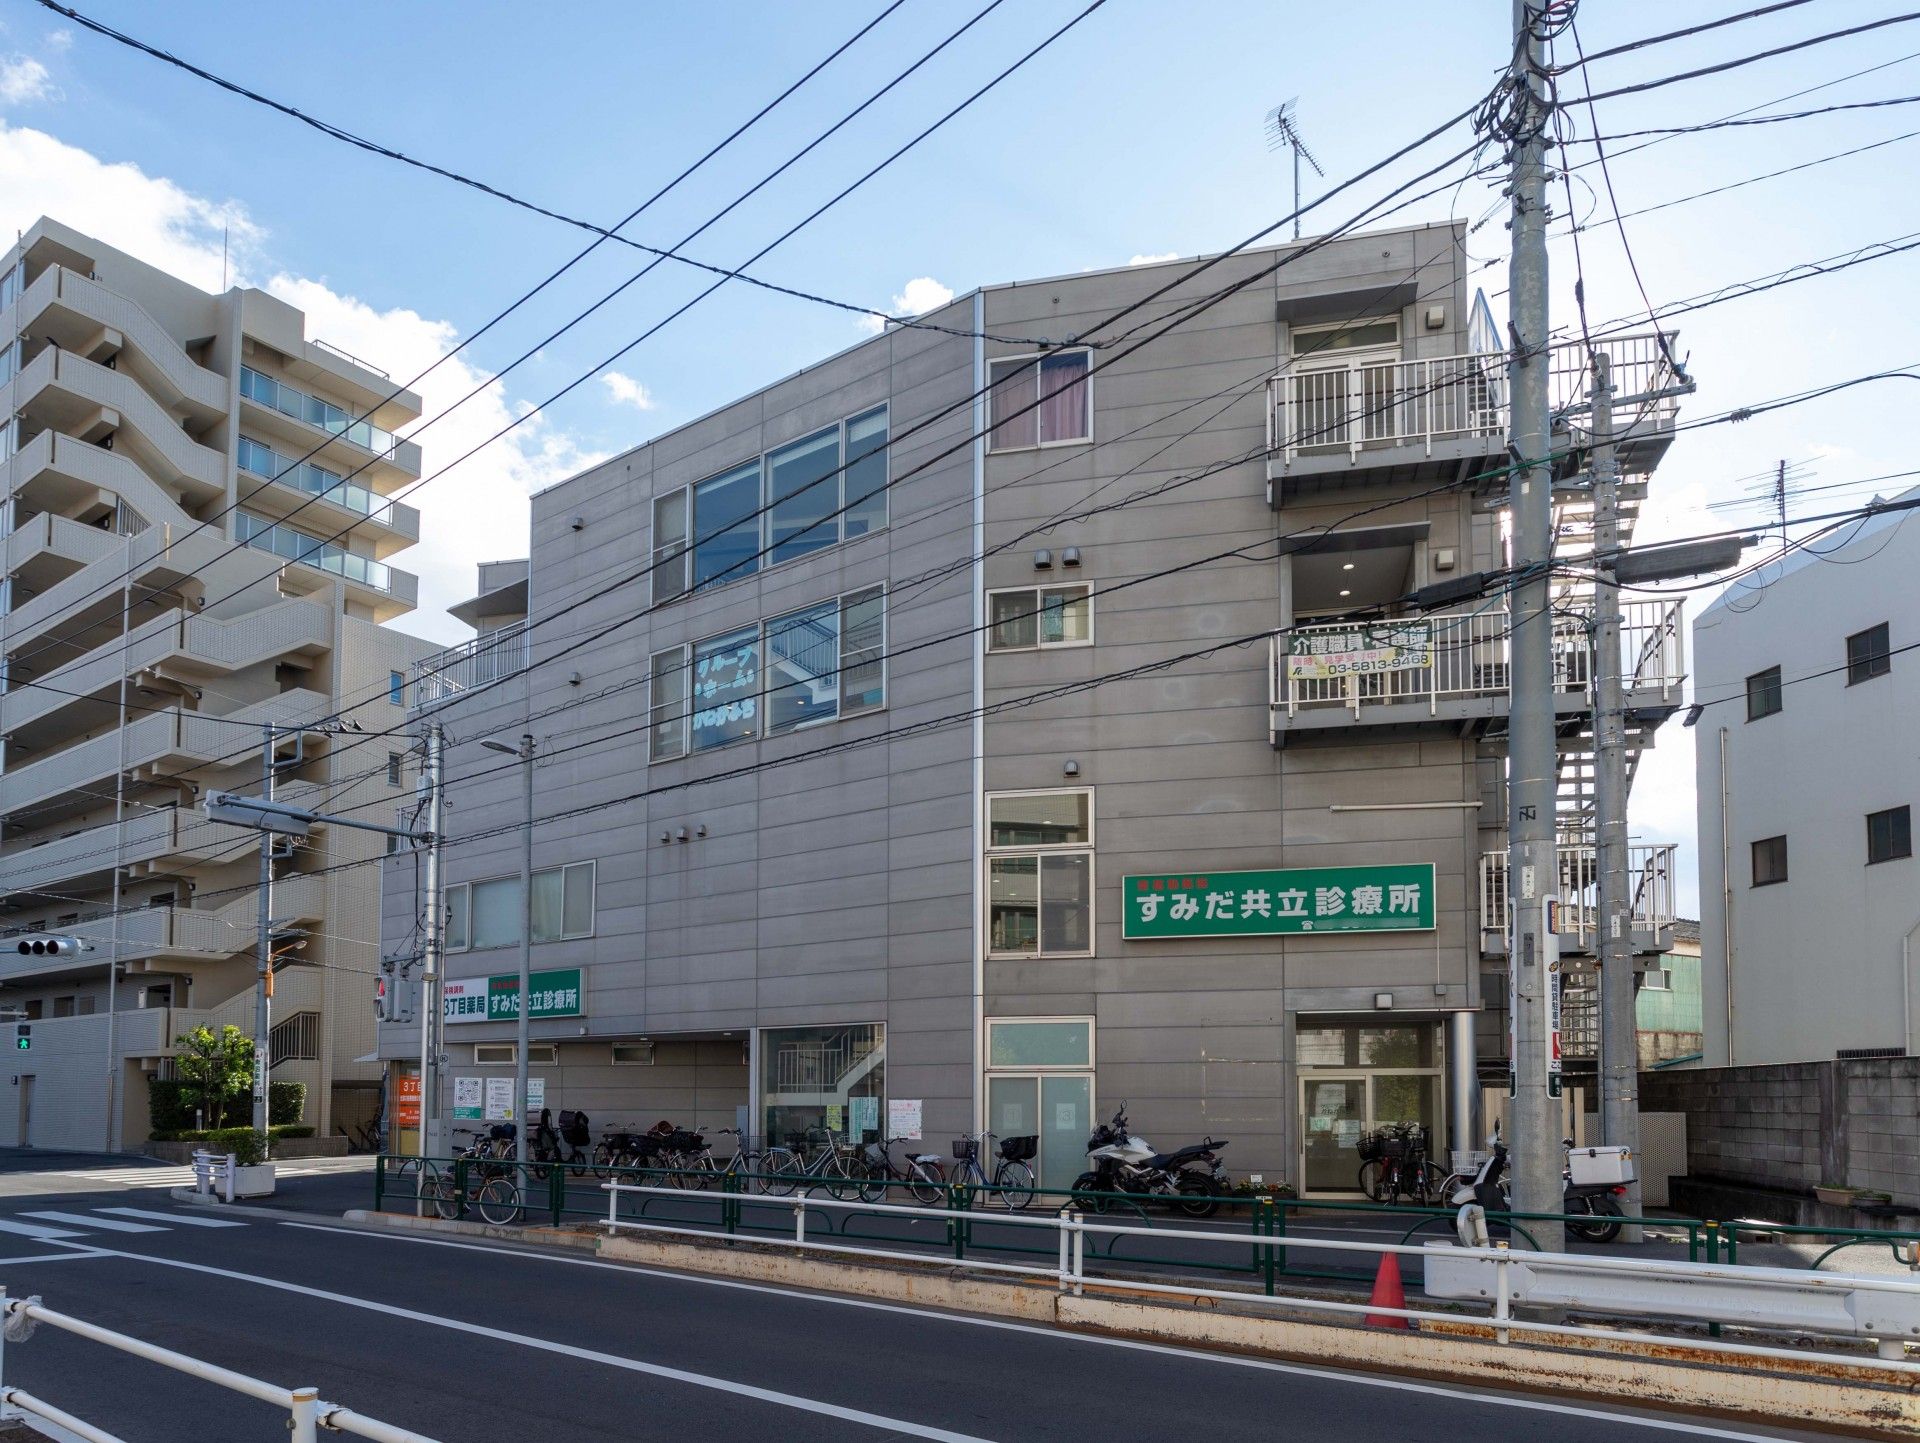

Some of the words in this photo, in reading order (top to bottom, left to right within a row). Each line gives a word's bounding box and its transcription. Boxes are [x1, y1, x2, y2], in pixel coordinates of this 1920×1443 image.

[1328, 655, 1429, 675] 03-5813-9468
[1136, 883, 1421, 922] すみだ共立診療所
[491, 988, 577, 1013] すみだ立診療所
